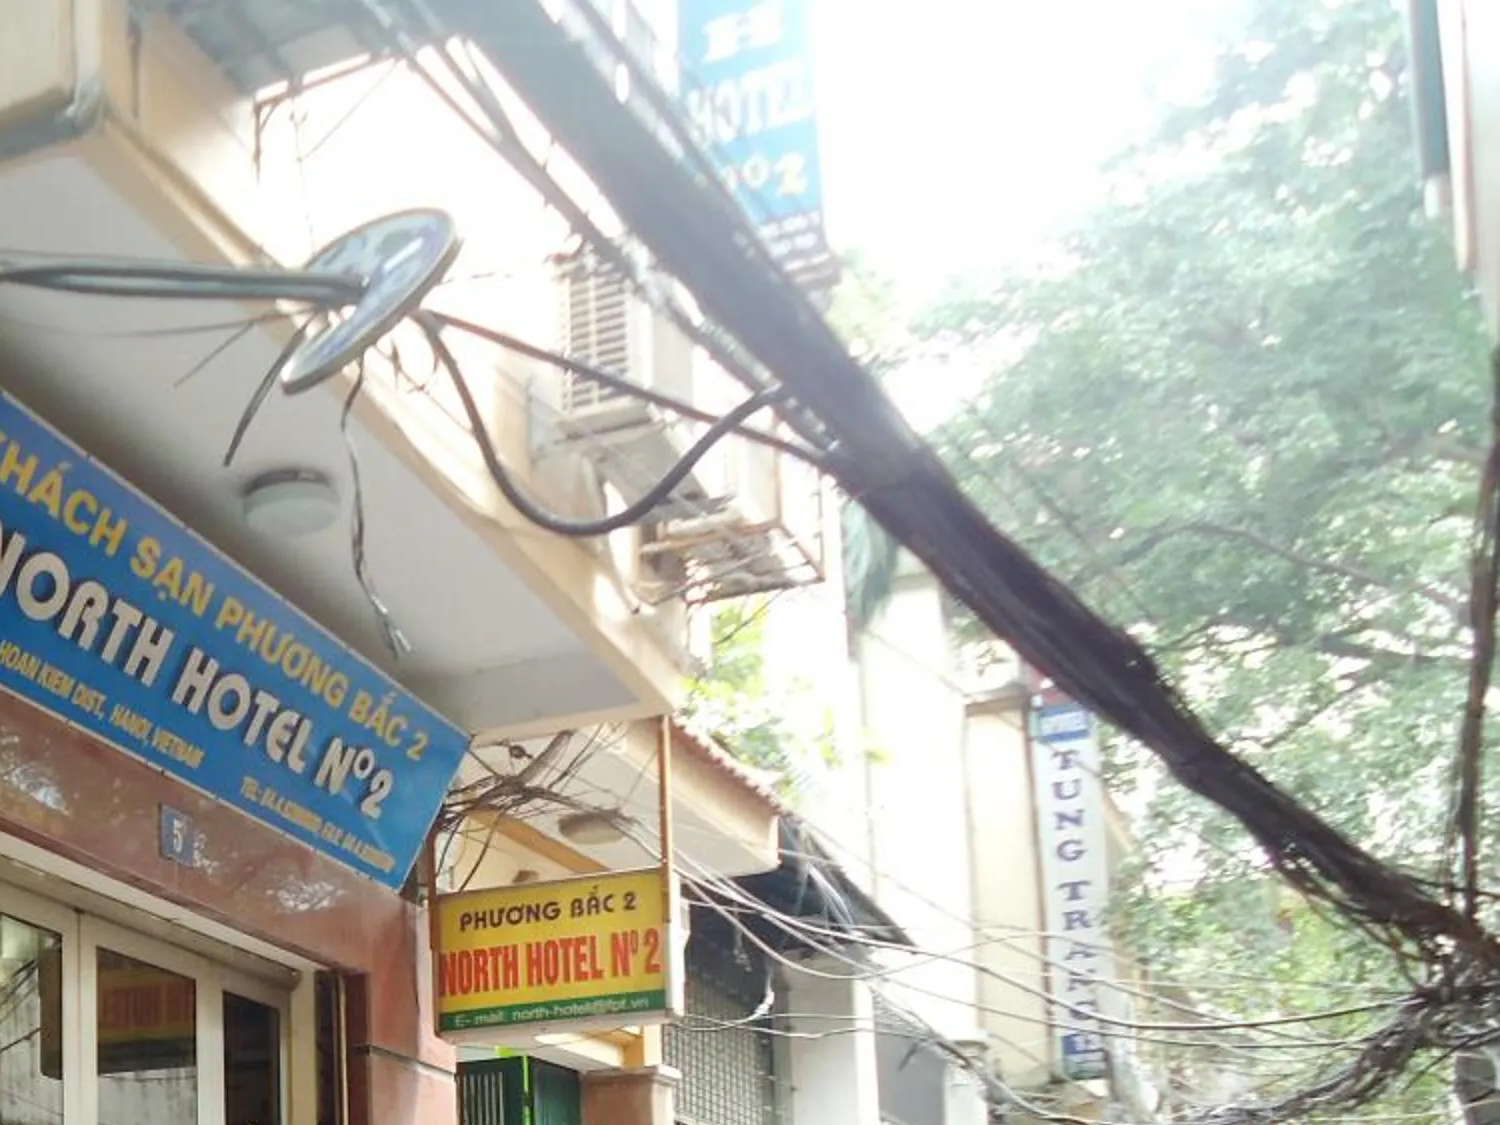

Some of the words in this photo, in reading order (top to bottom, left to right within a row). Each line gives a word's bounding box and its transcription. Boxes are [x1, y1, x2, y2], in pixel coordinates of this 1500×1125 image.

[130, 536, 214, 616] SẠN
[406, 730, 429, 762] 2
[172, 647, 314, 774] HOTEL
[459, 901, 561, 932] PHƯƠNG
[622, 891, 638, 912] 2
[438, 943, 520, 997] NORTH
[526, 935, 605, 988] HOTEL
[643, 927, 662, 975] 2
